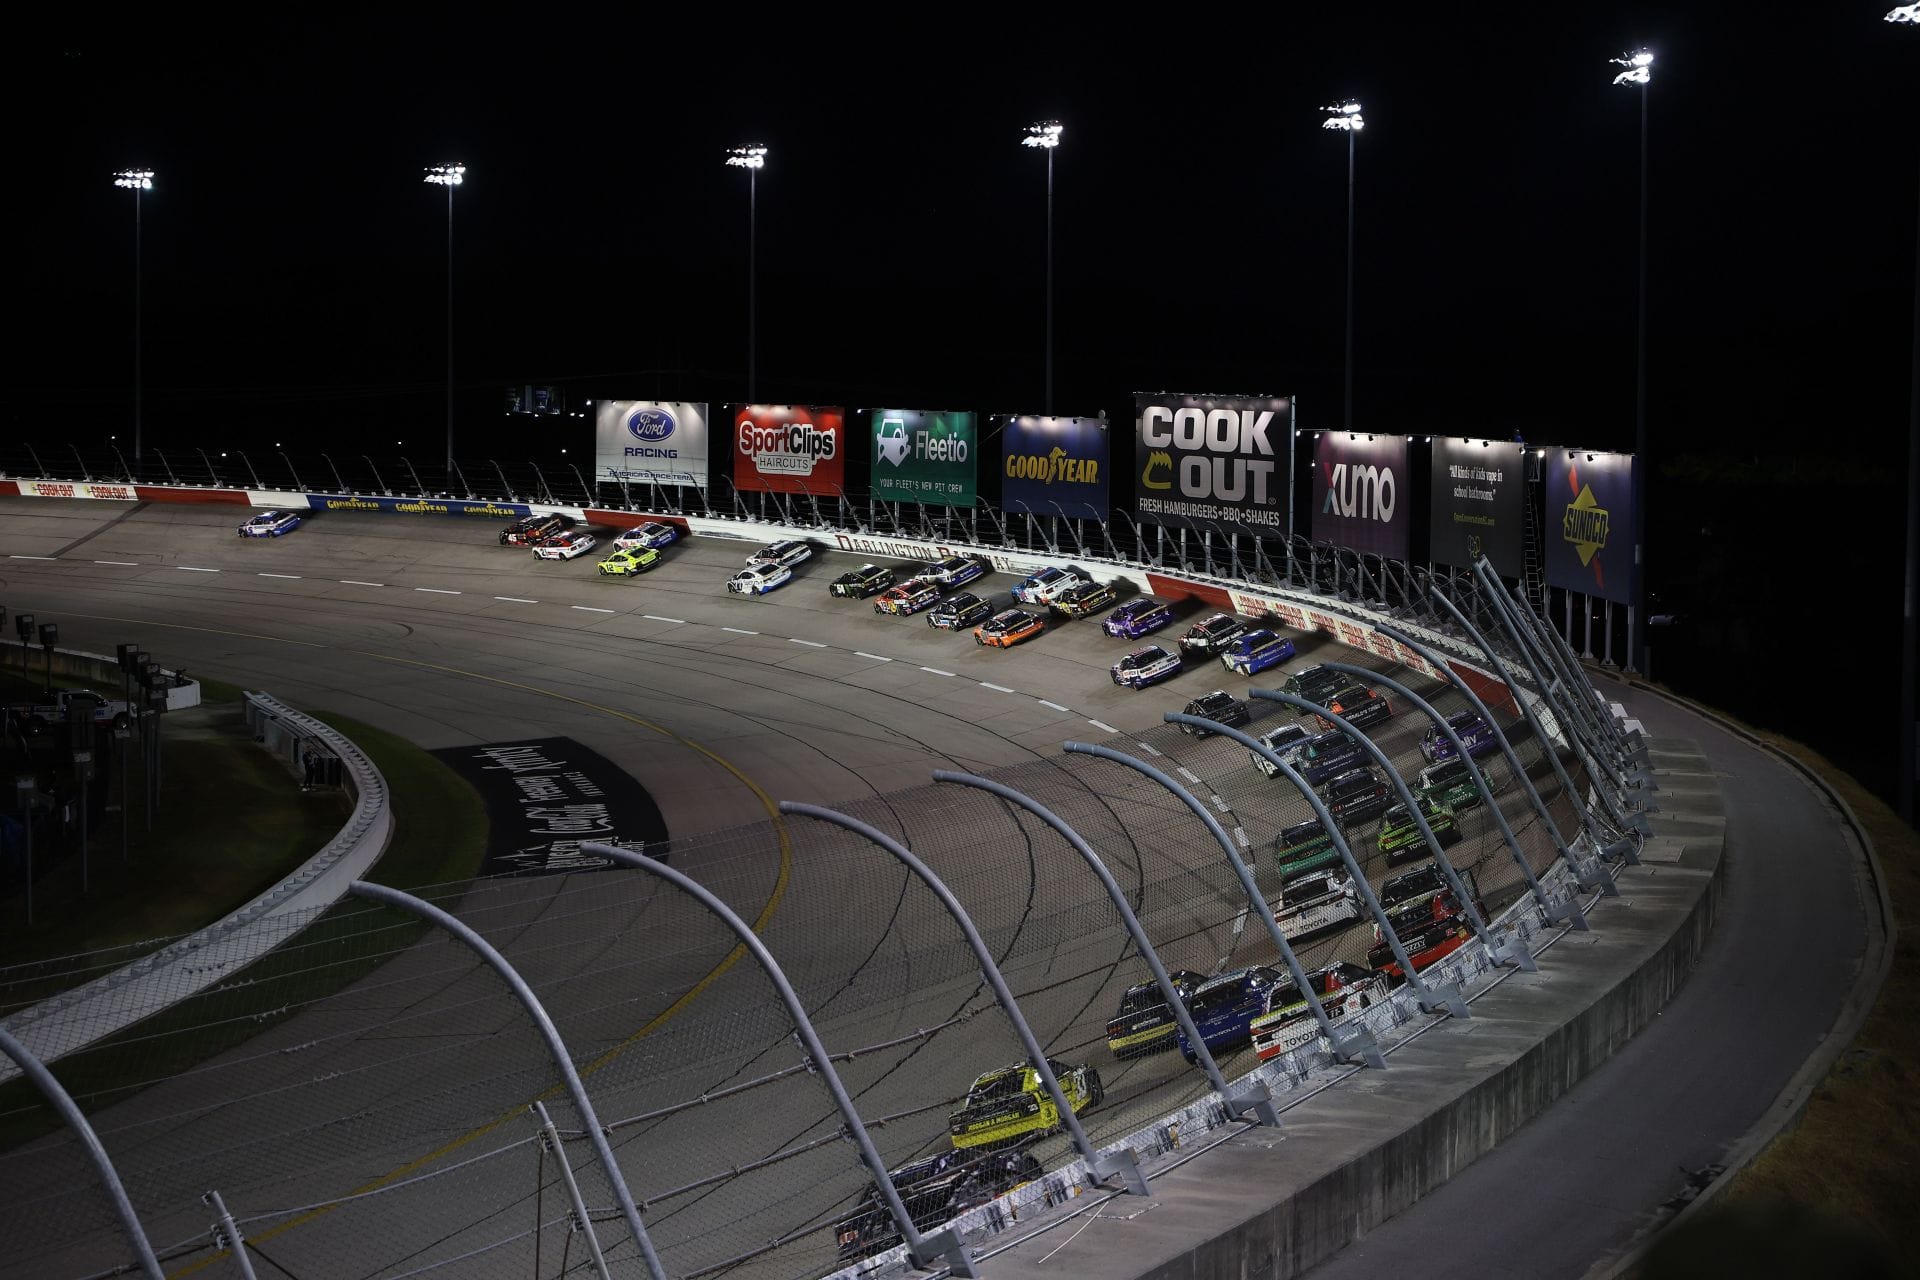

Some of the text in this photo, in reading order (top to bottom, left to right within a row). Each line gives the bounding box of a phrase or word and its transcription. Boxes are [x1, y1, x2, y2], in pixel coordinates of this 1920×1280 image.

[637, 412, 666, 436] Ford
[1142, 405, 1275, 455] COOK
[625, 447, 677, 458] RACING
[915, 430, 967, 463] Fleetio
[760, 457, 809, 469] HAIRCUTS
[1006, 454, 1098, 483] GOODYEAR
[1179, 455, 1275, 505] OUT
[1475, 466, 1485, 480] kids
[1486, 470, 1496, 484] vape
[1497, 468, 1503, 482] in
[37, 484, 76, 497] COOK OUT
[90, 486, 130, 499] COOK OUT
[880, 478, 962, 493] YOUR FLEET'S NEW PIT CREW
[1454, 485, 1468, 498] school
[327, 499, 379, 510] GOODYEAR
[395, 502, 448, 513] GOODYEAR
[463, 505, 516, 516] GOODYEAR
[1139, 497, 1163, 512] FRESH
[1565, 508, 1607, 544] SUNOCO
[835, 534, 934, 560] DARLINGTON
[606, 563, 613, 571] 12
[1301, 918, 1329, 930] TOYOTA
